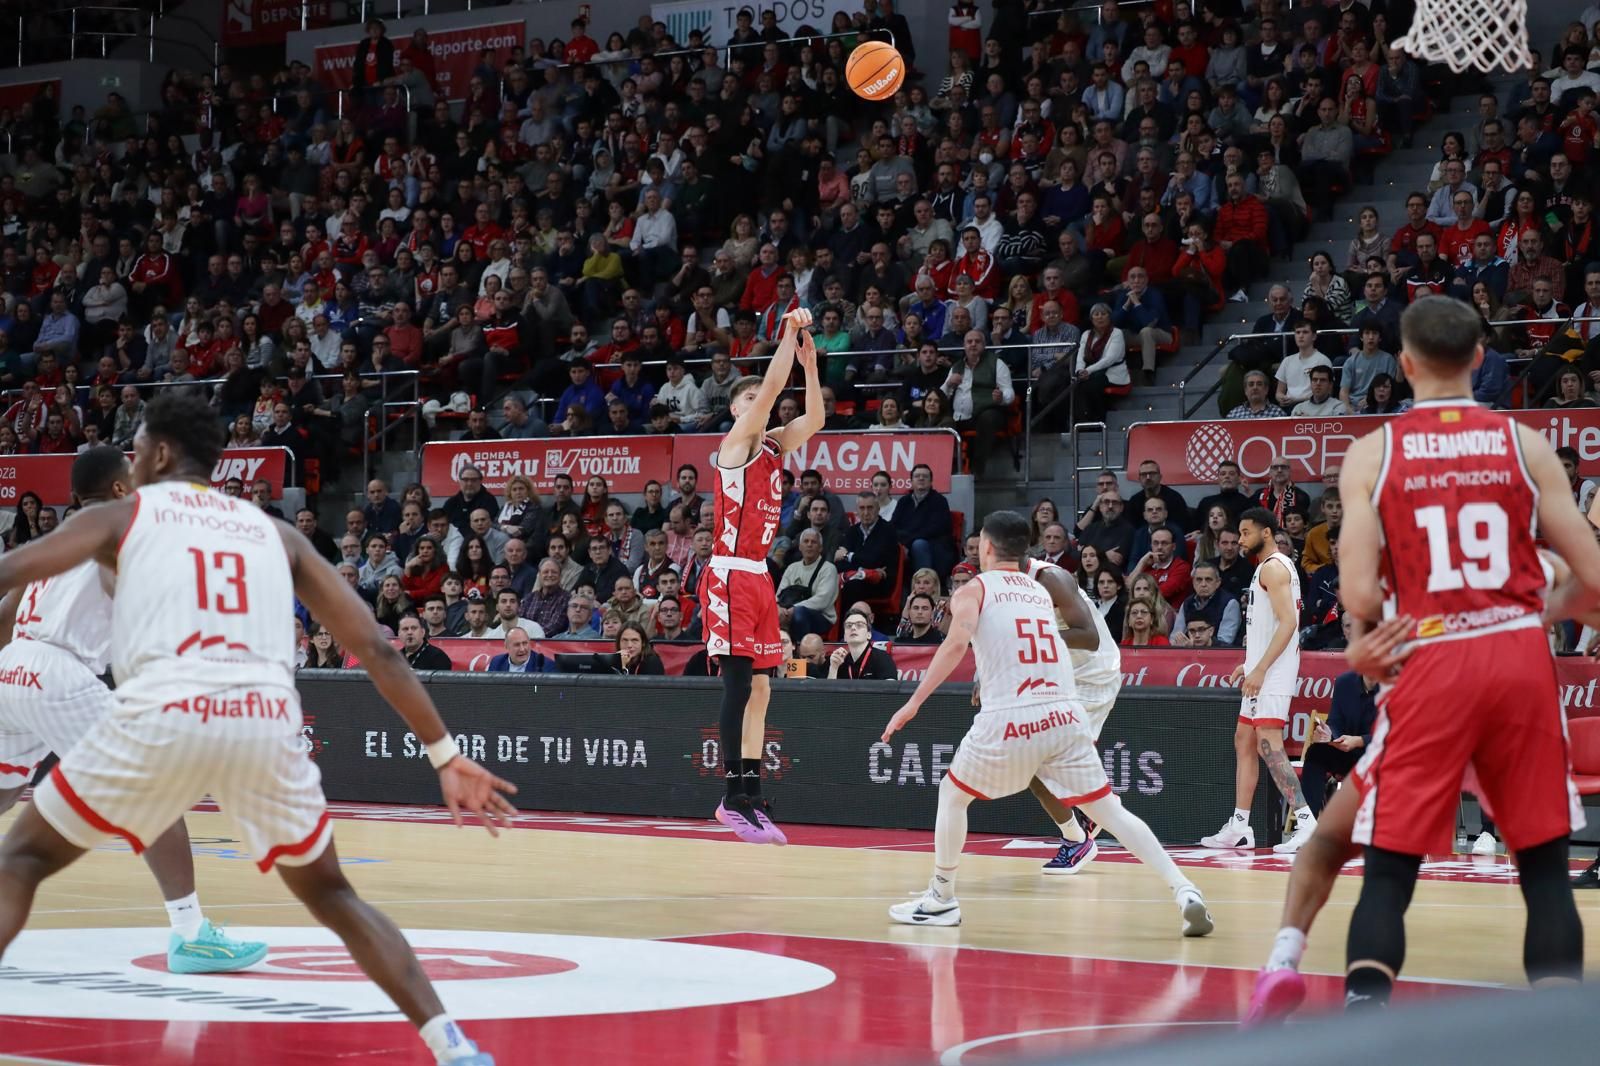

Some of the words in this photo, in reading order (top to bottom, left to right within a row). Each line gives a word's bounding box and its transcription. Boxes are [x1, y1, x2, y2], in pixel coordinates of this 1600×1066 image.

[863, 68, 898, 95] Wilson
[1294, 422, 1343, 434] GRUPO
[474, 451, 520, 461] BOMBAS
[581, 447, 629, 457] BOMBAS
[579, 457, 641, 475] VOLUM
[836, 478, 852, 489] DE
[1403, 475, 1427, 491] AIR
[1414, 502, 1511, 592] 19
[188, 547, 249, 615] 13
[1015, 618, 1059, 664] 55
[1003, 710, 1081, 741] Aquaflix
[365, 731, 392, 757] EL
[403, 732, 486, 761] SAOR
[497, 735, 529, 763] DE
[541, 737, 572, 764] TU
[584, 738, 648, 767] VIDA
